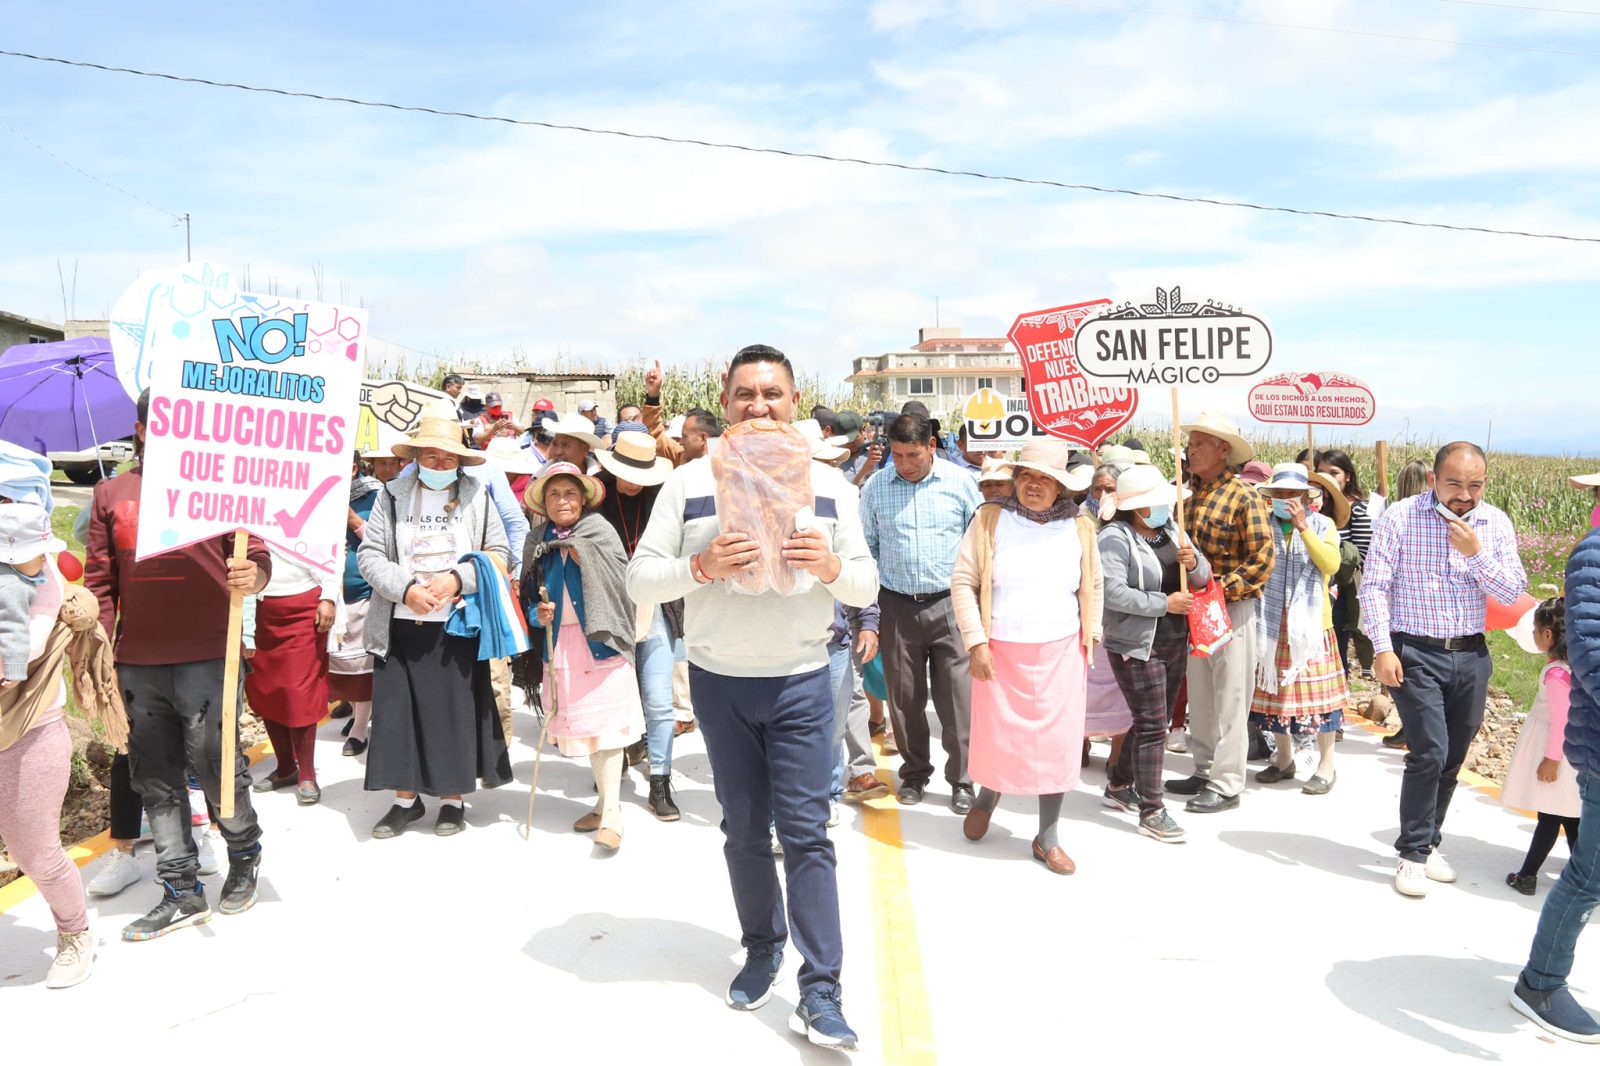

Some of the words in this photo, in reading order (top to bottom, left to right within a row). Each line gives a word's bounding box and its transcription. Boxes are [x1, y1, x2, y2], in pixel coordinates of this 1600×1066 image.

[211, 313, 308, 364] NO!
[1095, 328, 1147, 361] SAN
[1158, 327, 1251, 360] FELIPE
[181, 360, 325, 403] MEJORALITOS
[1127, 362, 1220, 384] MÁGICO
[359, 388, 373, 402] DE
[1255, 393, 1264, 401] DE
[1281, 394, 1309, 402] DICHOS
[1318, 395, 1332, 403] LOS
[1334, 396, 1368, 404] HECHOS,
[1255, 402, 1272, 416] AQUÍ
[1274, 404, 1299, 417] ESTAN
[1300, 405, 1315, 418] LOS
[1316, 406, 1369, 419] RESULTADOS.
[150, 396, 345, 454] SOLUCIONES
[179, 450, 225, 482] QUE
[232, 455, 310, 490] DURAN
[166, 488, 180, 518] Y
